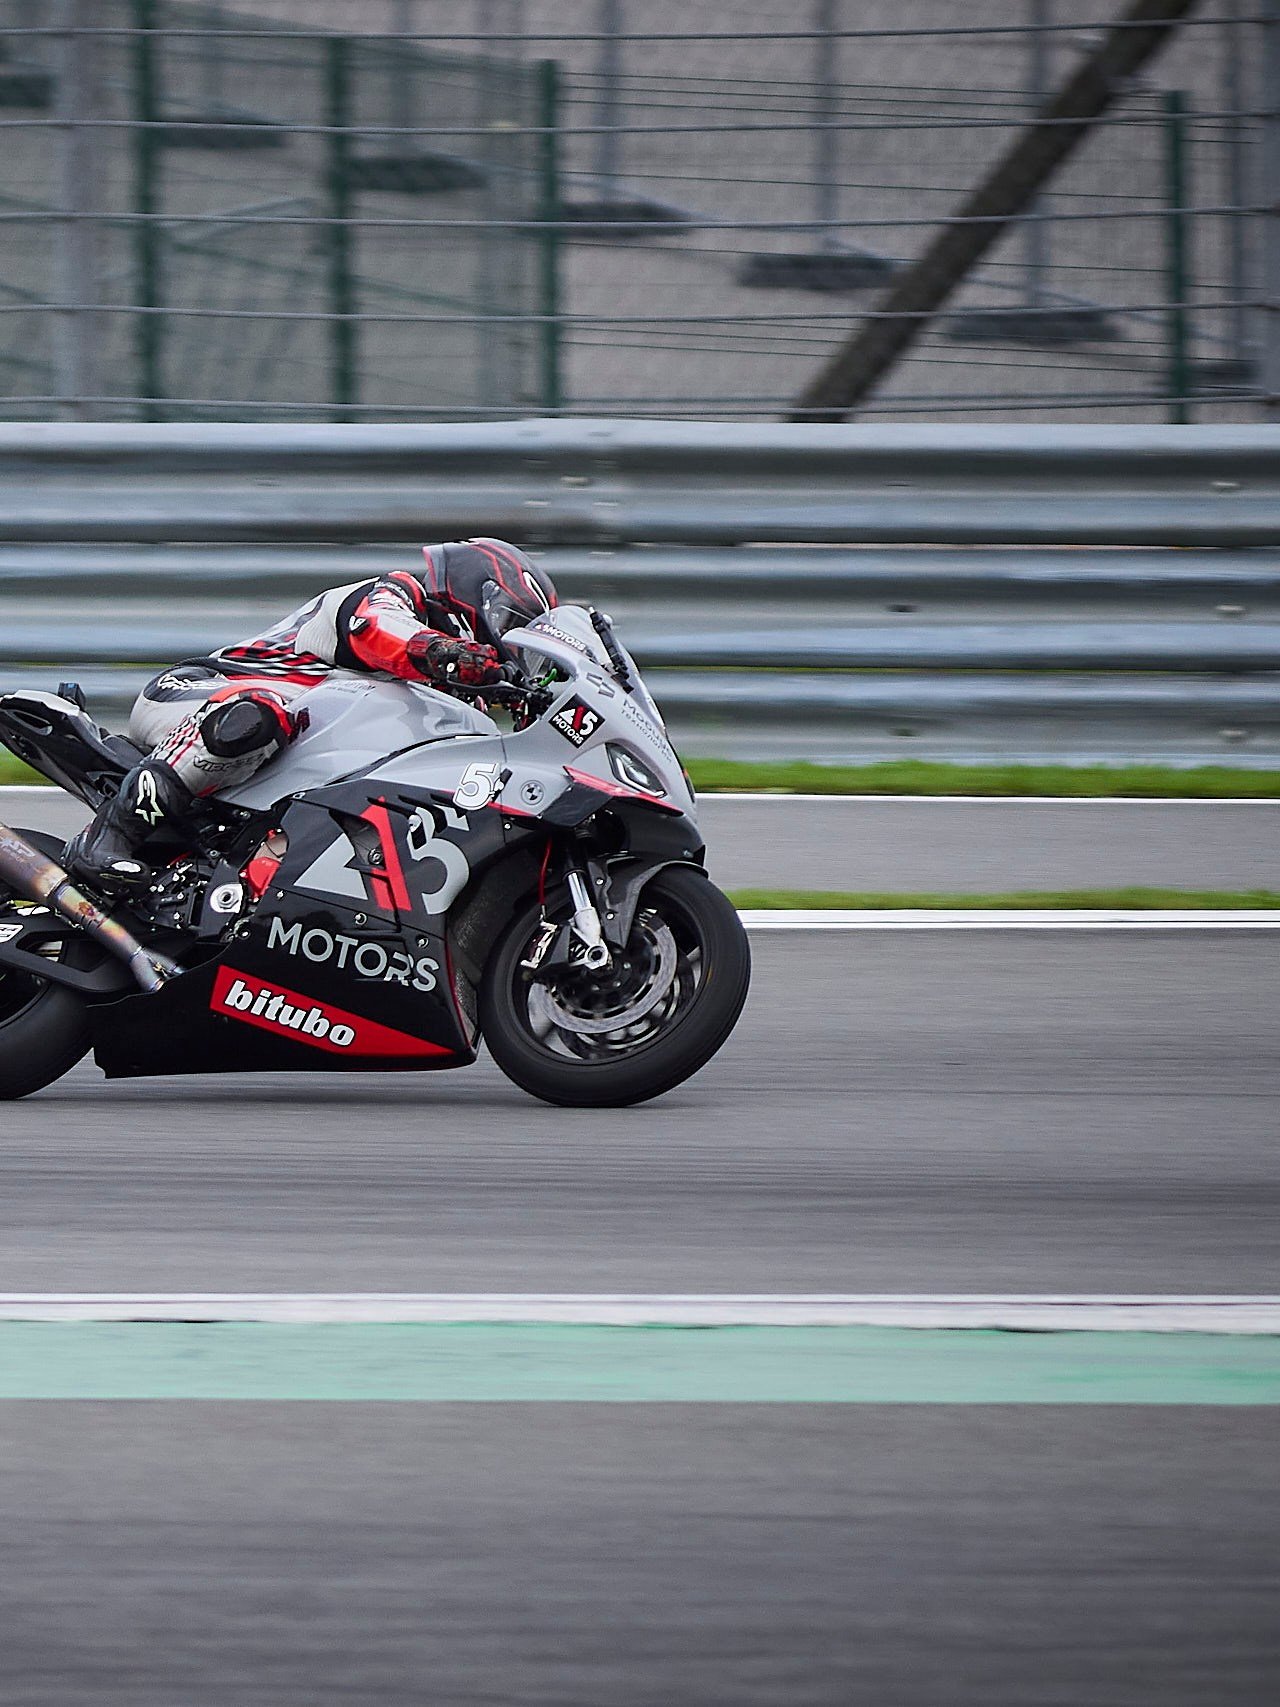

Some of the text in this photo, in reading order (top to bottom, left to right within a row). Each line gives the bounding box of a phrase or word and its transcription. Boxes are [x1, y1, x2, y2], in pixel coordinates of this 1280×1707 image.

[552, 714, 584, 745] MOTORS
[266, 916, 440, 992] MOTORS
[224, 979, 356, 1047] bitubo
